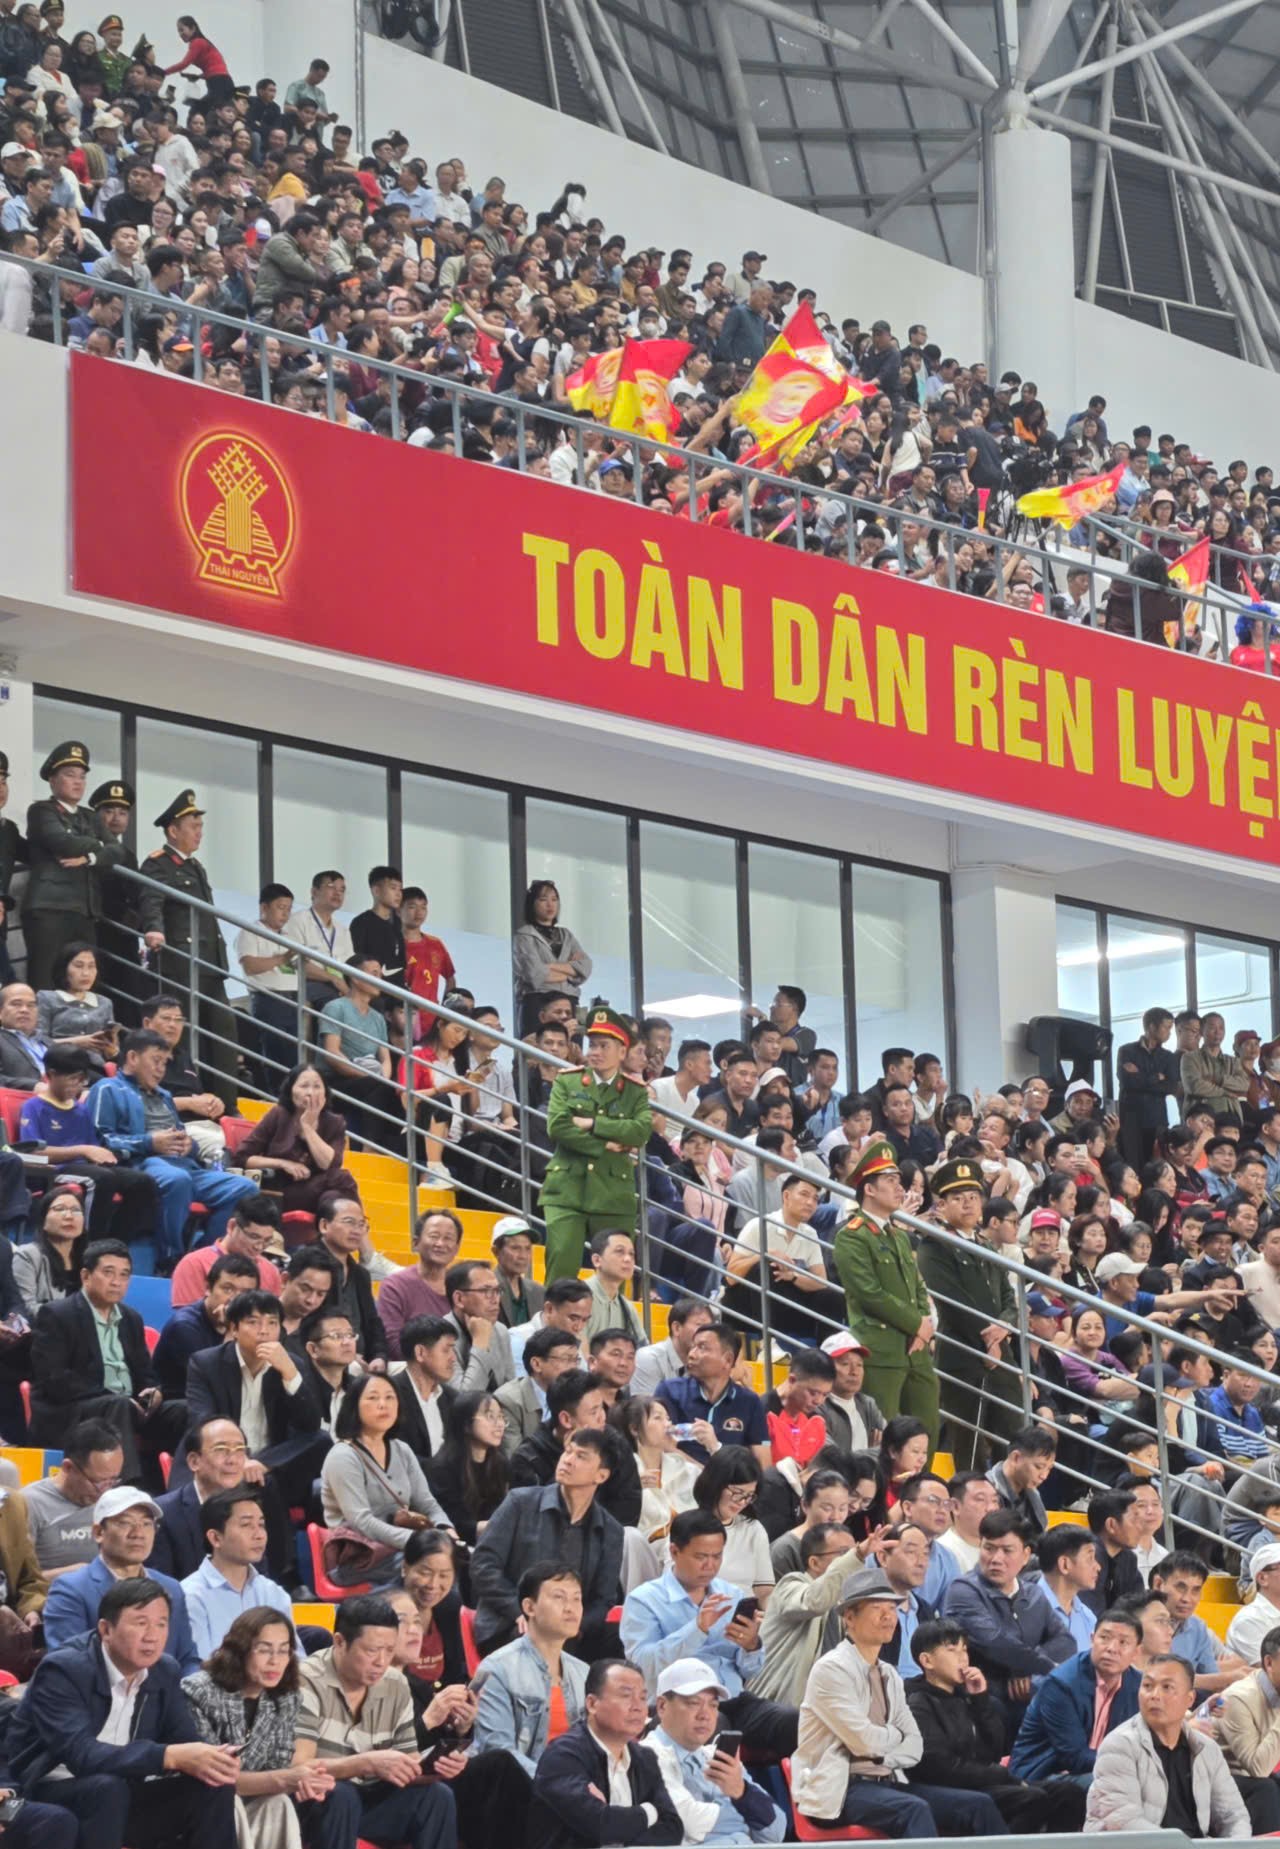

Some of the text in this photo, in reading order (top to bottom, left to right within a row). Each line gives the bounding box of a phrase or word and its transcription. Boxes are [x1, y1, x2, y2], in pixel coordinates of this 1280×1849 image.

[522, 533, 744, 690] TOÀN
[772, 593, 927, 734] DÂN
[952, 638, 1094, 774] RÈN
[423, 969, 433, 985] 3
